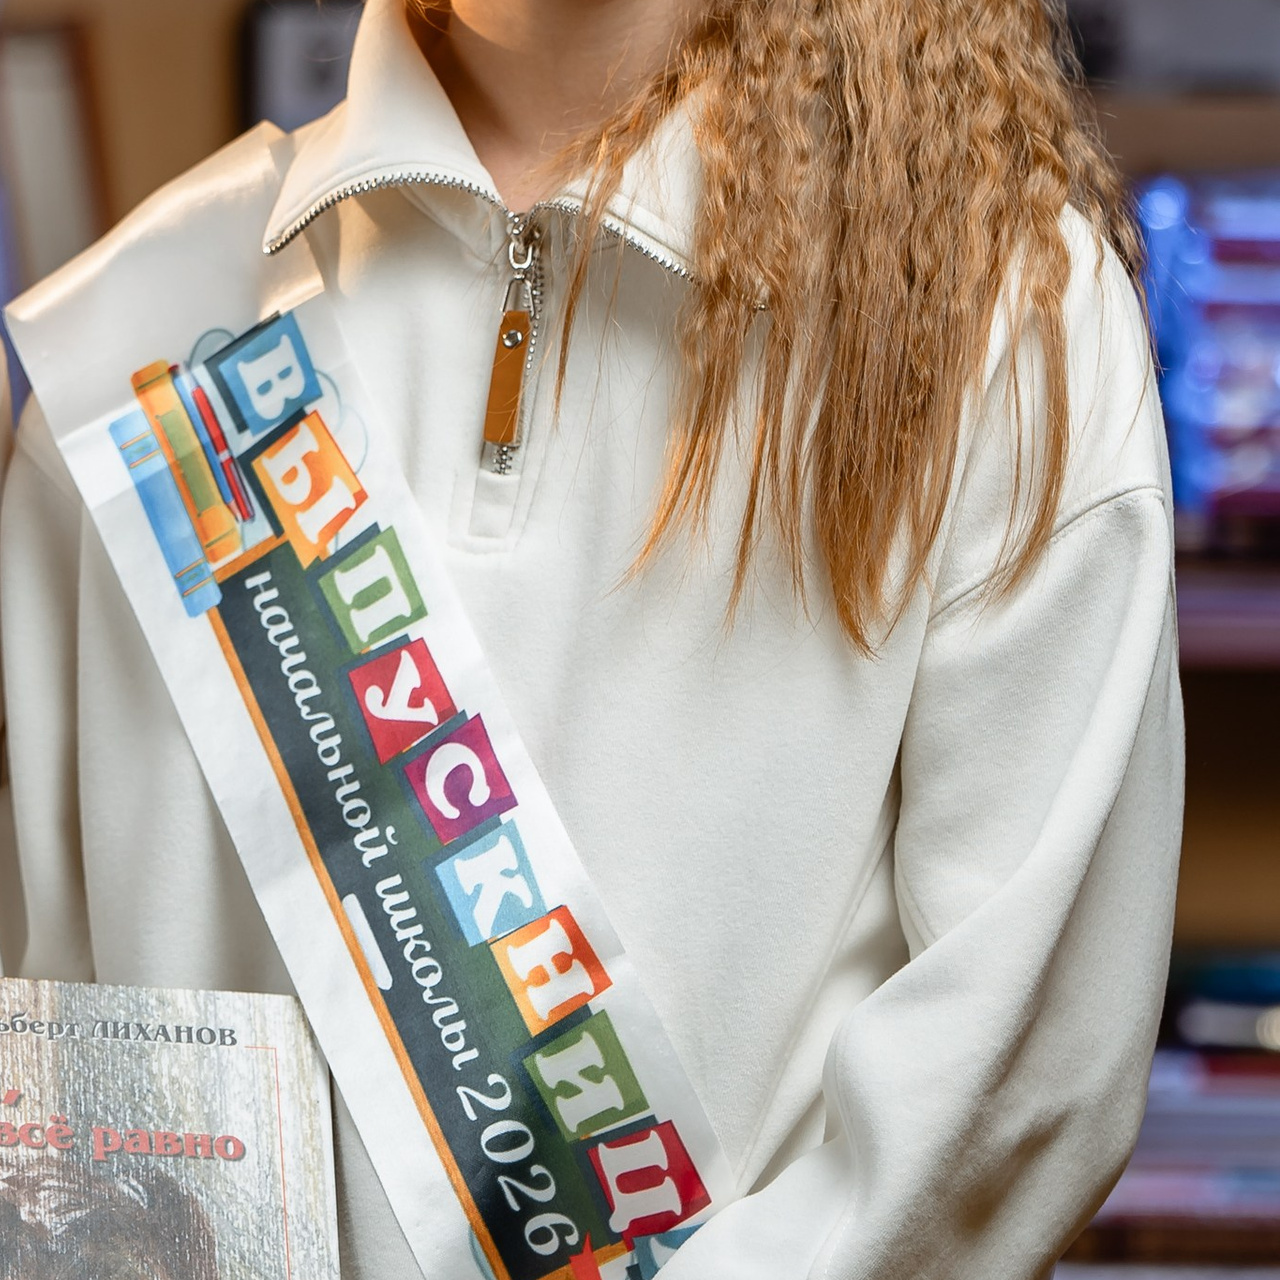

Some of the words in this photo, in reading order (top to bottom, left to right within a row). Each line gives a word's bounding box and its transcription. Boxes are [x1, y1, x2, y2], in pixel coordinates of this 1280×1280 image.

[237, 333, 682, 1269] ВЫПУСКНИЦ
[244, 570, 398, 868] начальной
[375, 874, 479, 1071] школы
[456, 1073, 579, 1257] 2026
[91, 1019, 238, 1047] ЛИХАНОВ
[91, 1124, 247, 1162] равно
